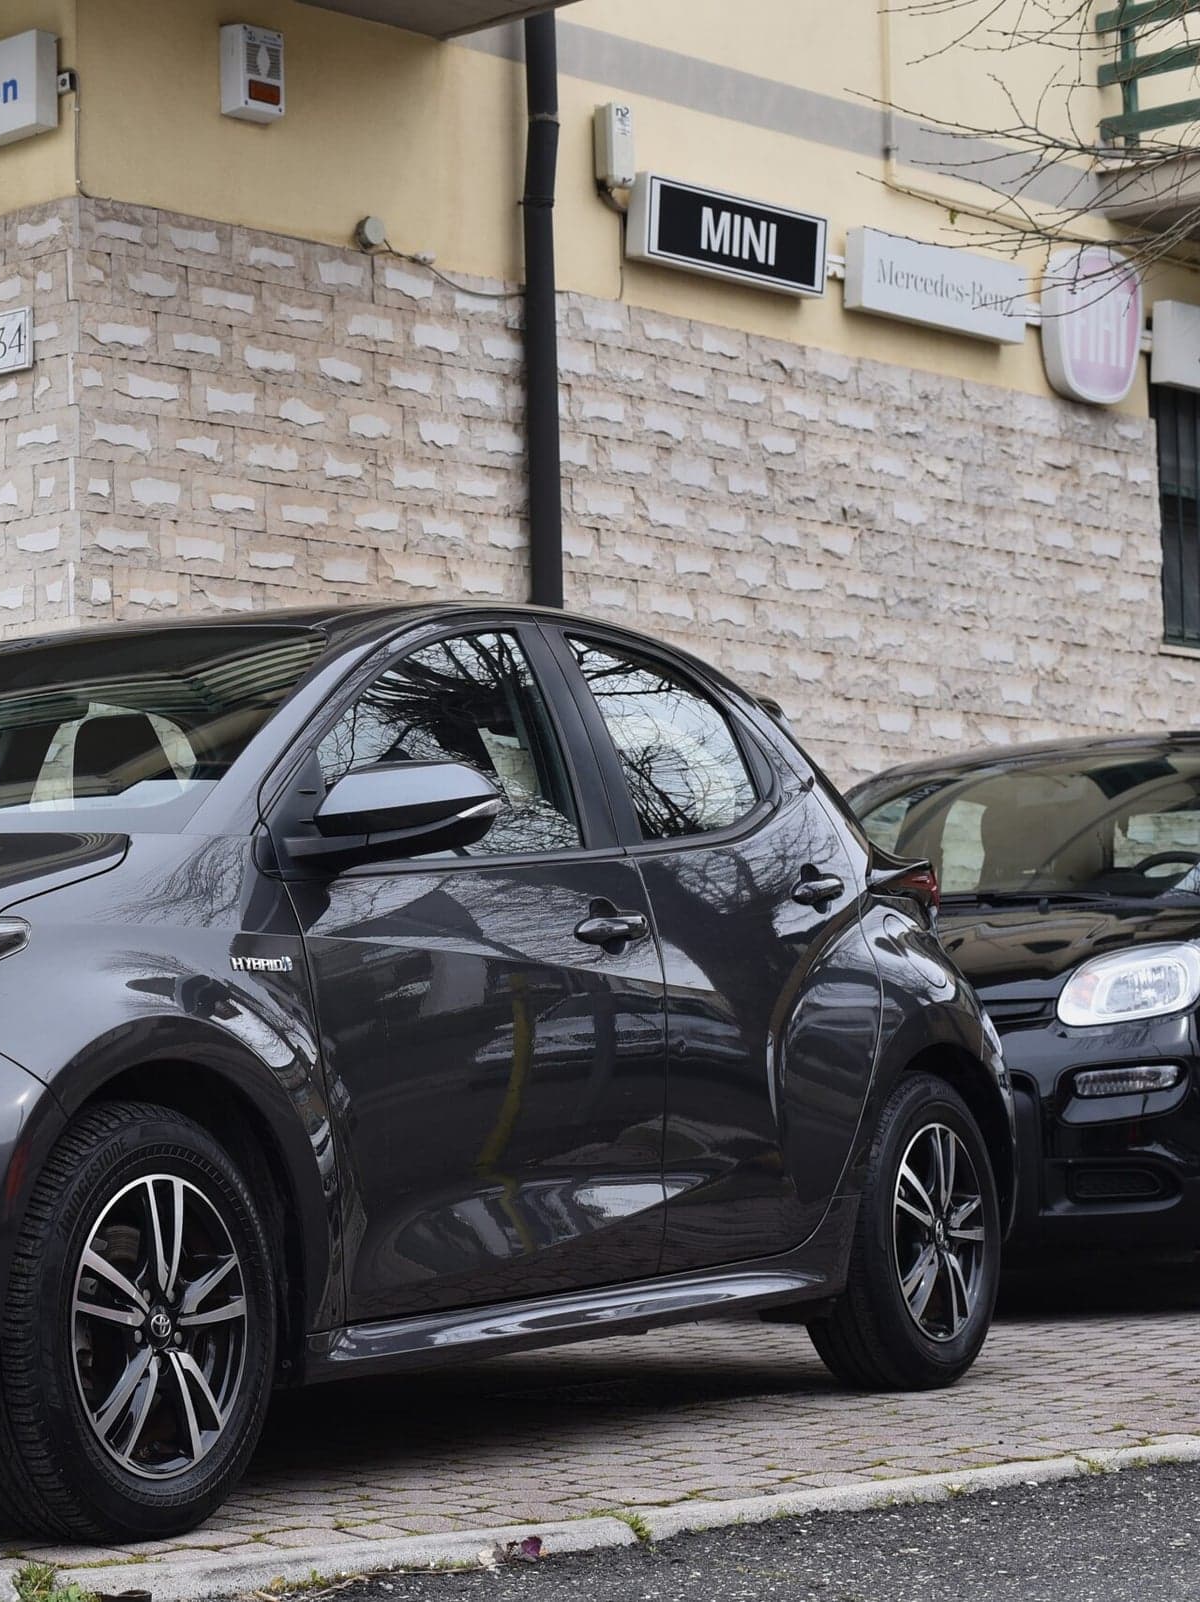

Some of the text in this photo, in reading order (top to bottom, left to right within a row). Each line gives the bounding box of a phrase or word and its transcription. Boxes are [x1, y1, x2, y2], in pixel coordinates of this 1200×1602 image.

[701, 205, 777, 266] MINI
[877, 258, 1015, 314] Mercedes-Benz
[1070, 286, 1132, 369] FIAT
[231, 956, 286, 973] HYBRID
